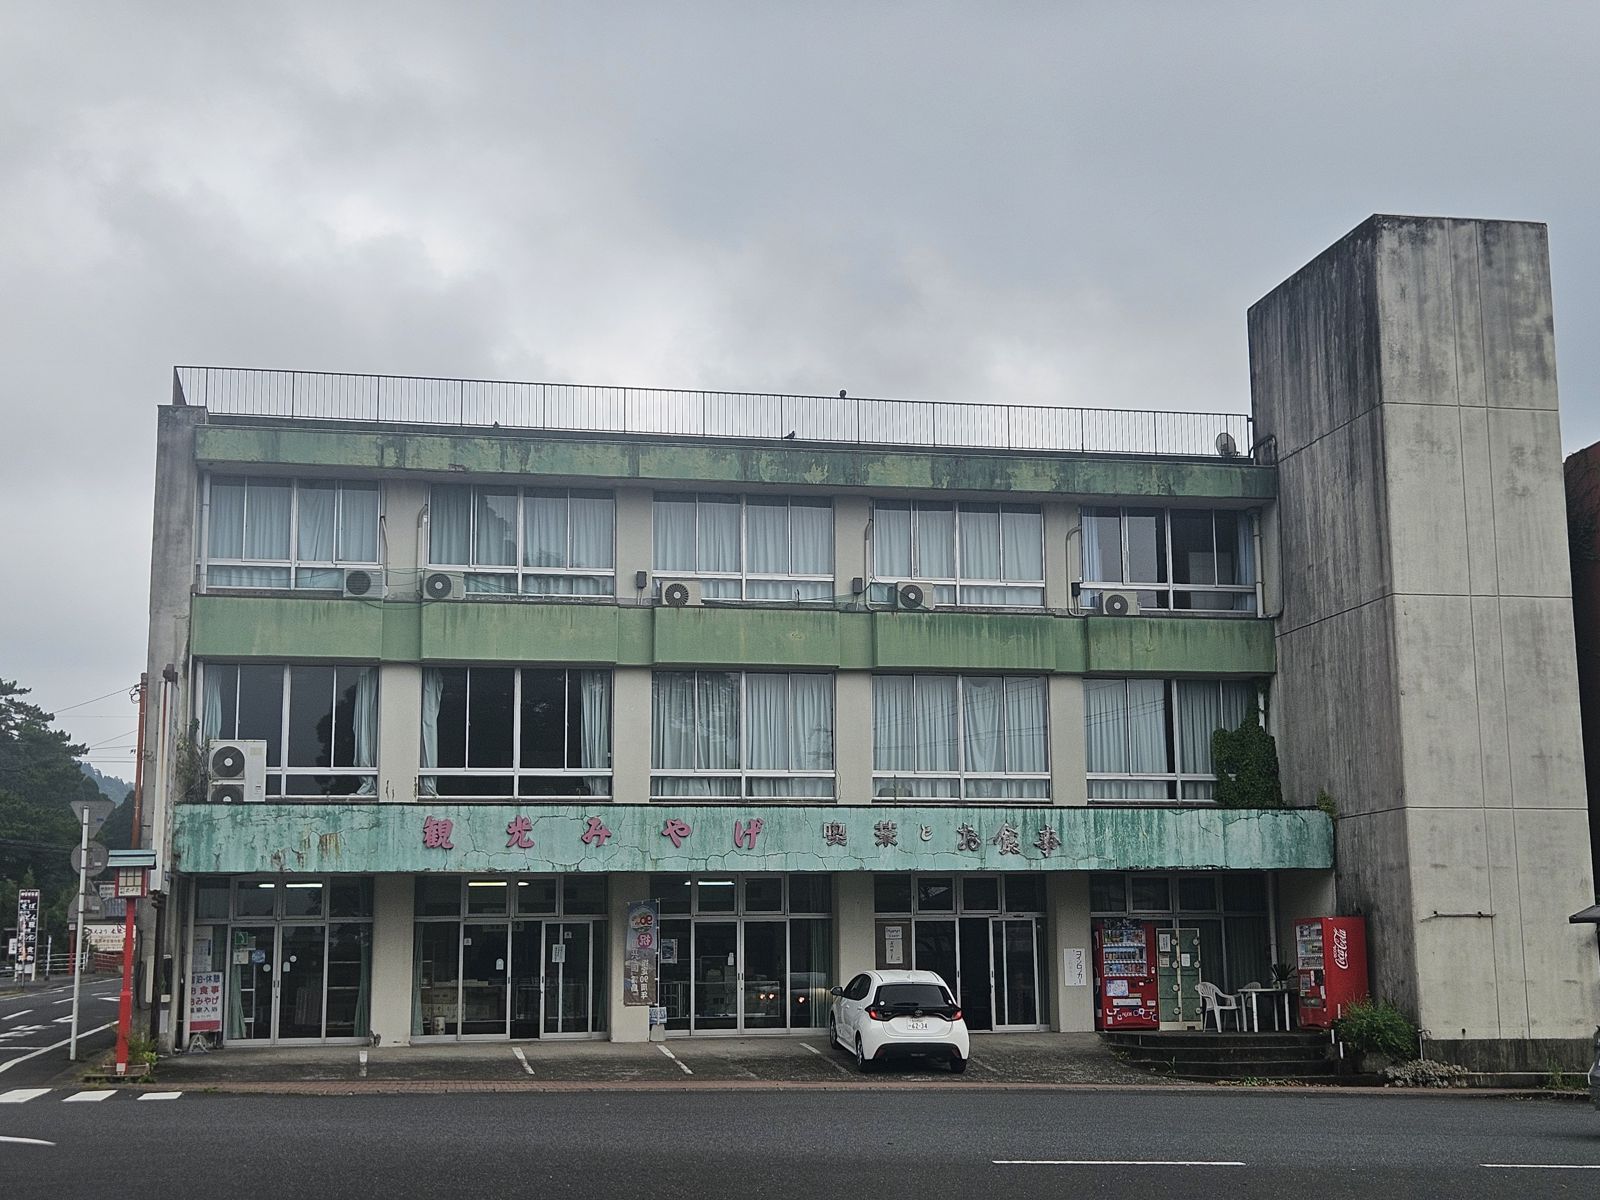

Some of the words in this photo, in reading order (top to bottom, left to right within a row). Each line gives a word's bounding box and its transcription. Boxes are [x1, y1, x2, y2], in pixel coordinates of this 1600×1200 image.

[423, 815, 765, 850] 観光みやげ
[1333, 927, 1349, 970] Coca-Cola
[1075, 950, 1083, 985] コインロッカー
